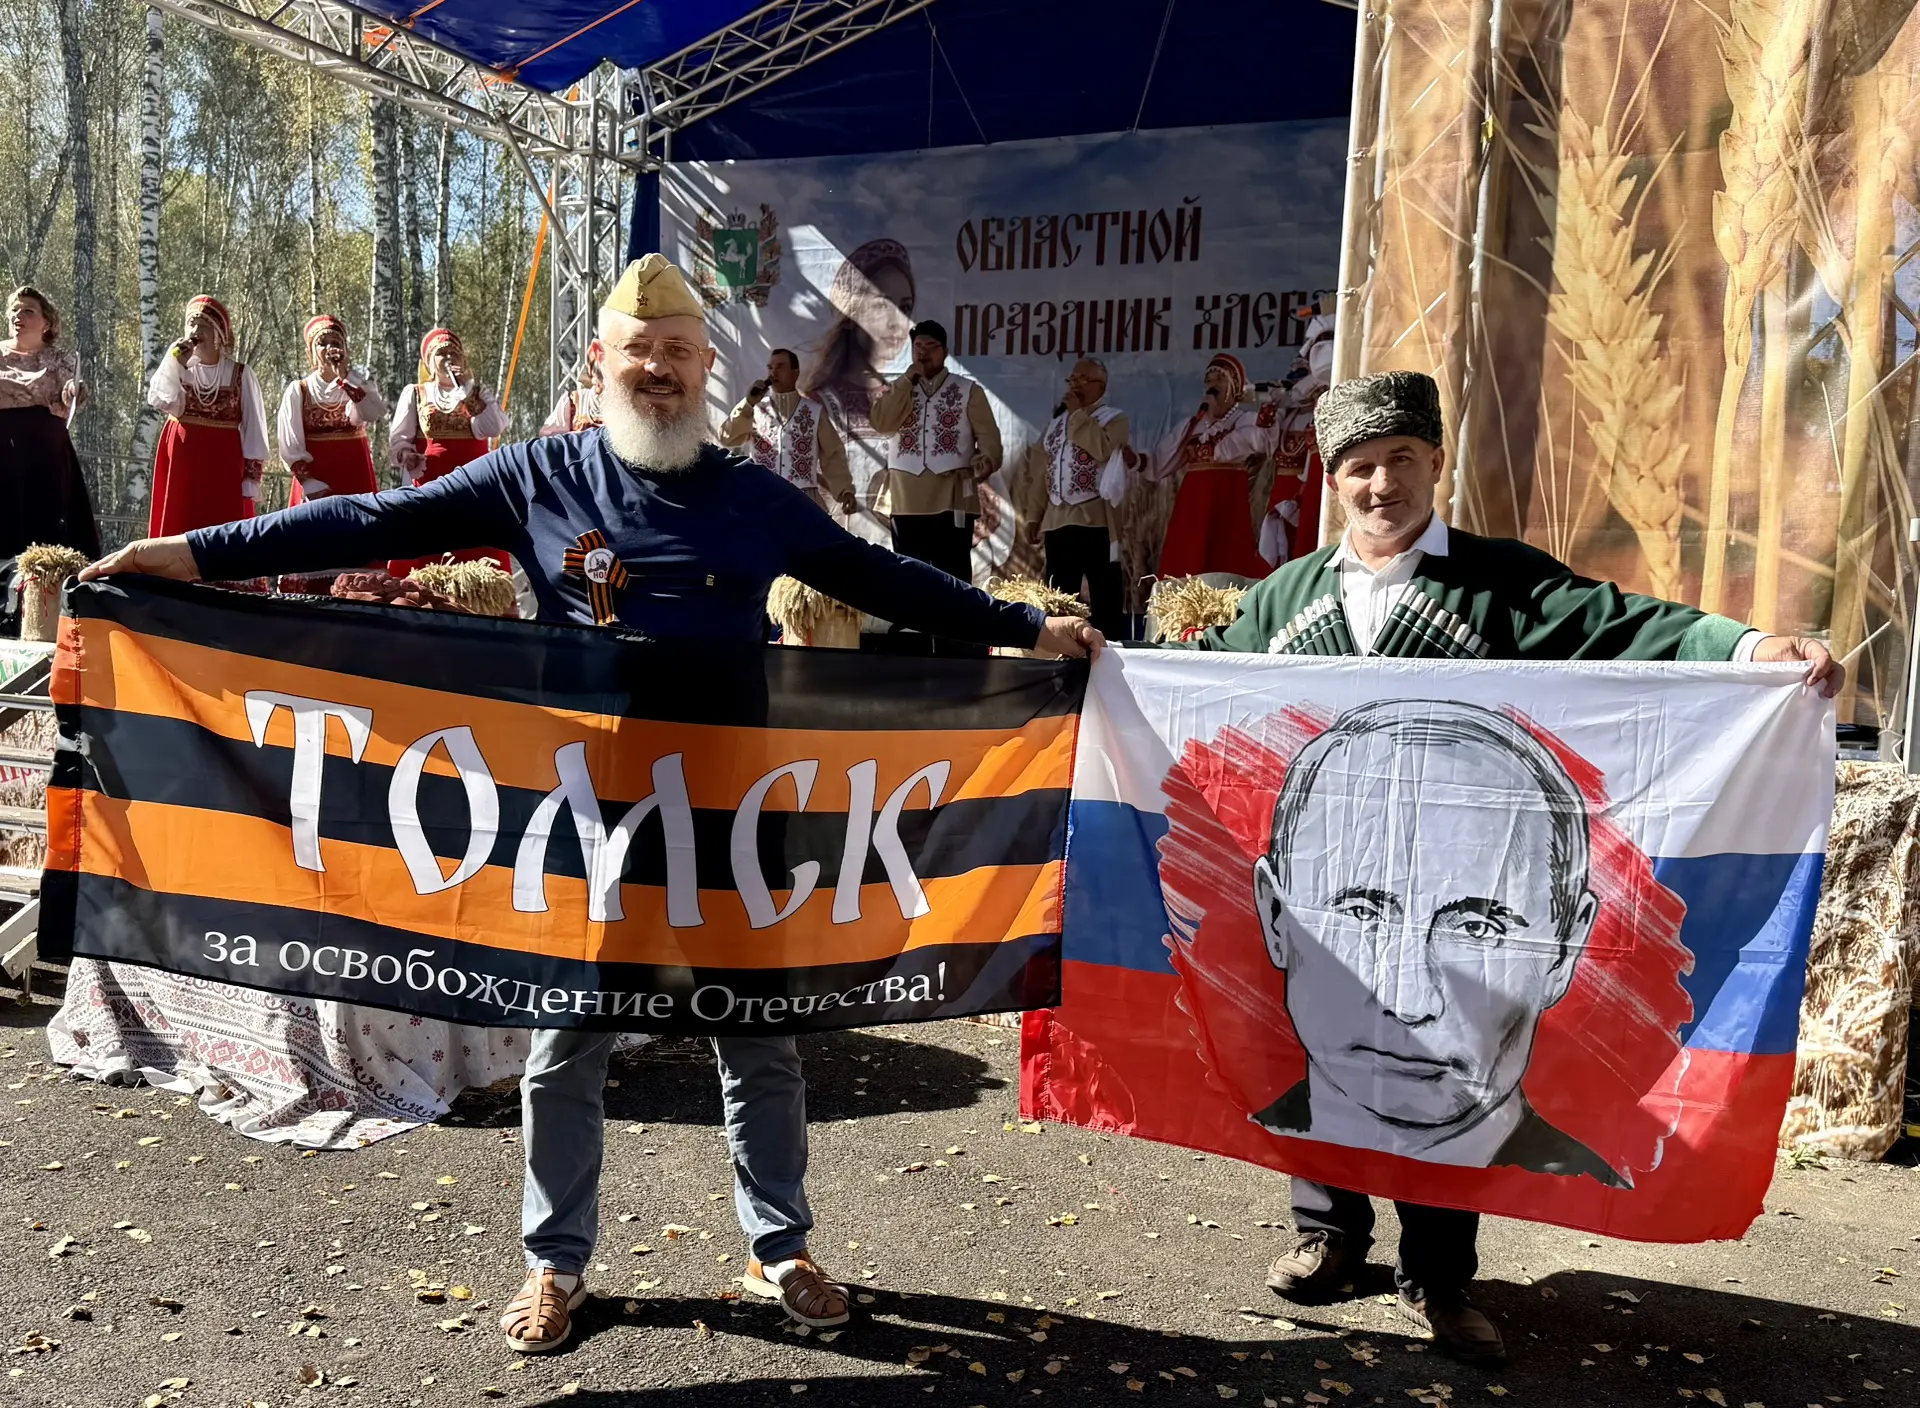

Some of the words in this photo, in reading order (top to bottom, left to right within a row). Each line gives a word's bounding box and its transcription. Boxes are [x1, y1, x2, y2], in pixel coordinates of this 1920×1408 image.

[957, 195, 1202, 273] ОБЛАСТНОЙ
[954, 296, 1171, 362] ПРАЗДНИК
[1193, 290, 1336, 348] ХЛЕБ
[203, 931, 259, 967] за
[279, 941, 673, 1019] освобождение
[690, 962, 945, 1023] Отечества!
